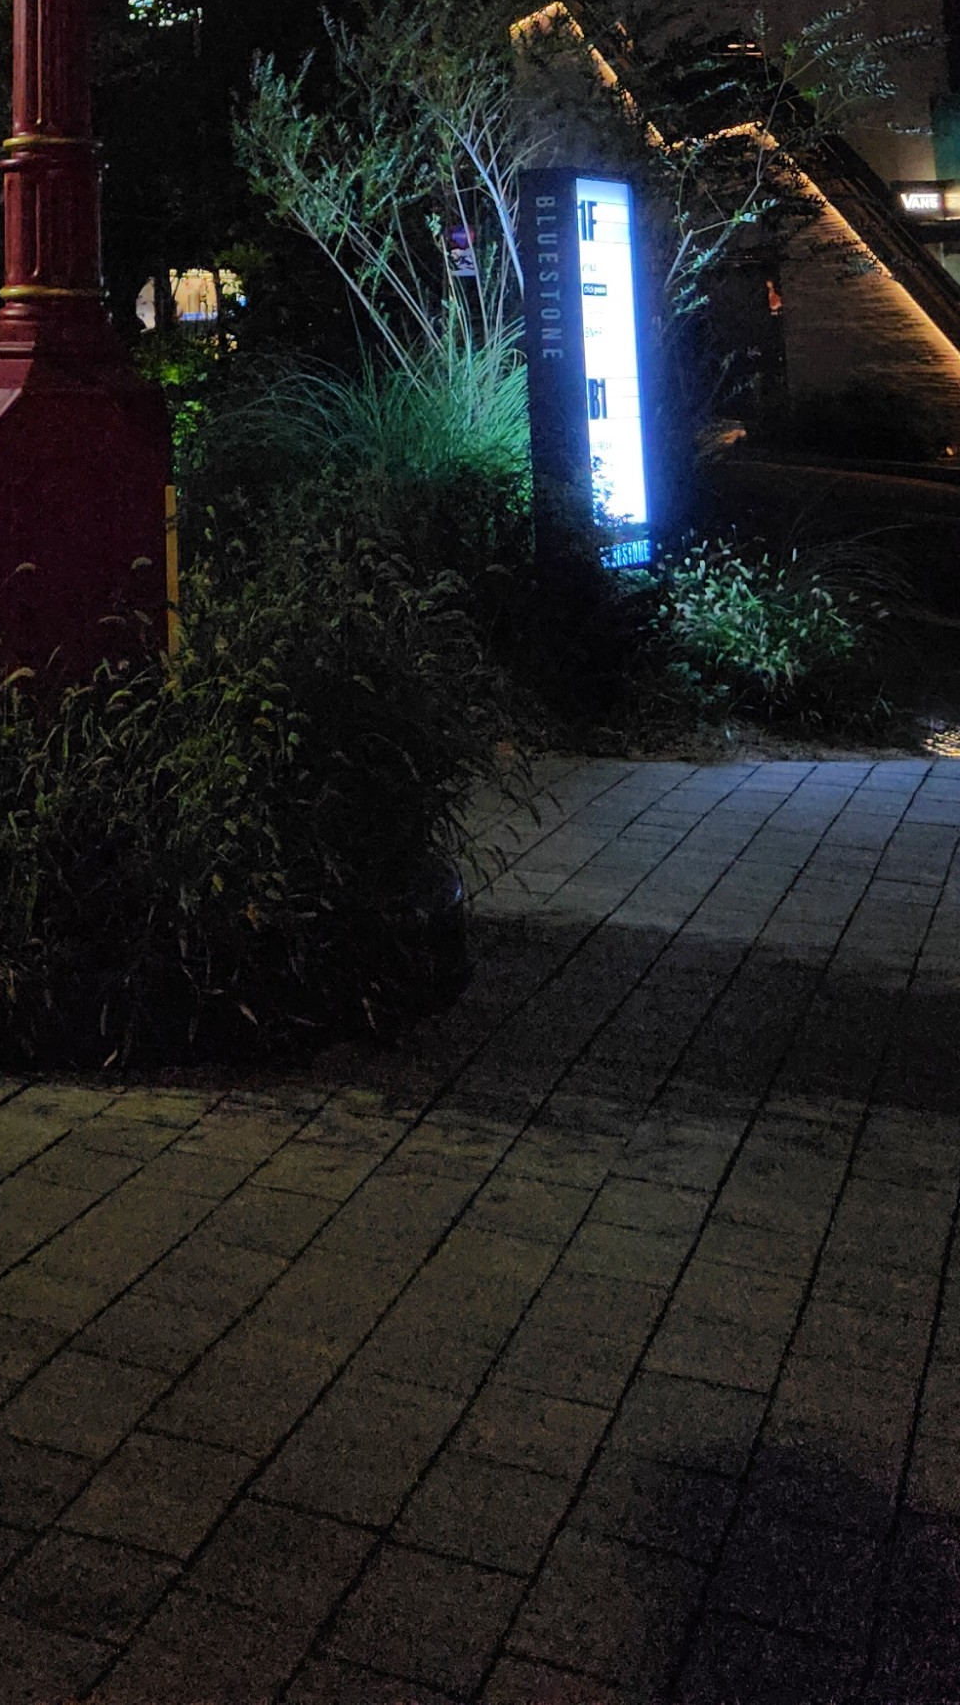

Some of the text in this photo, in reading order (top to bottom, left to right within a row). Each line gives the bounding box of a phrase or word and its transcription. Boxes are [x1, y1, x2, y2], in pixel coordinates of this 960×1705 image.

[577, 200, 598, 241] 1F
[900, 193, 940, 211] VANS
[536, 196, 564, 359] BLUESTONE
[587, 378, 608, 420] B1
[600, 539, 651, 568] ESTONE
